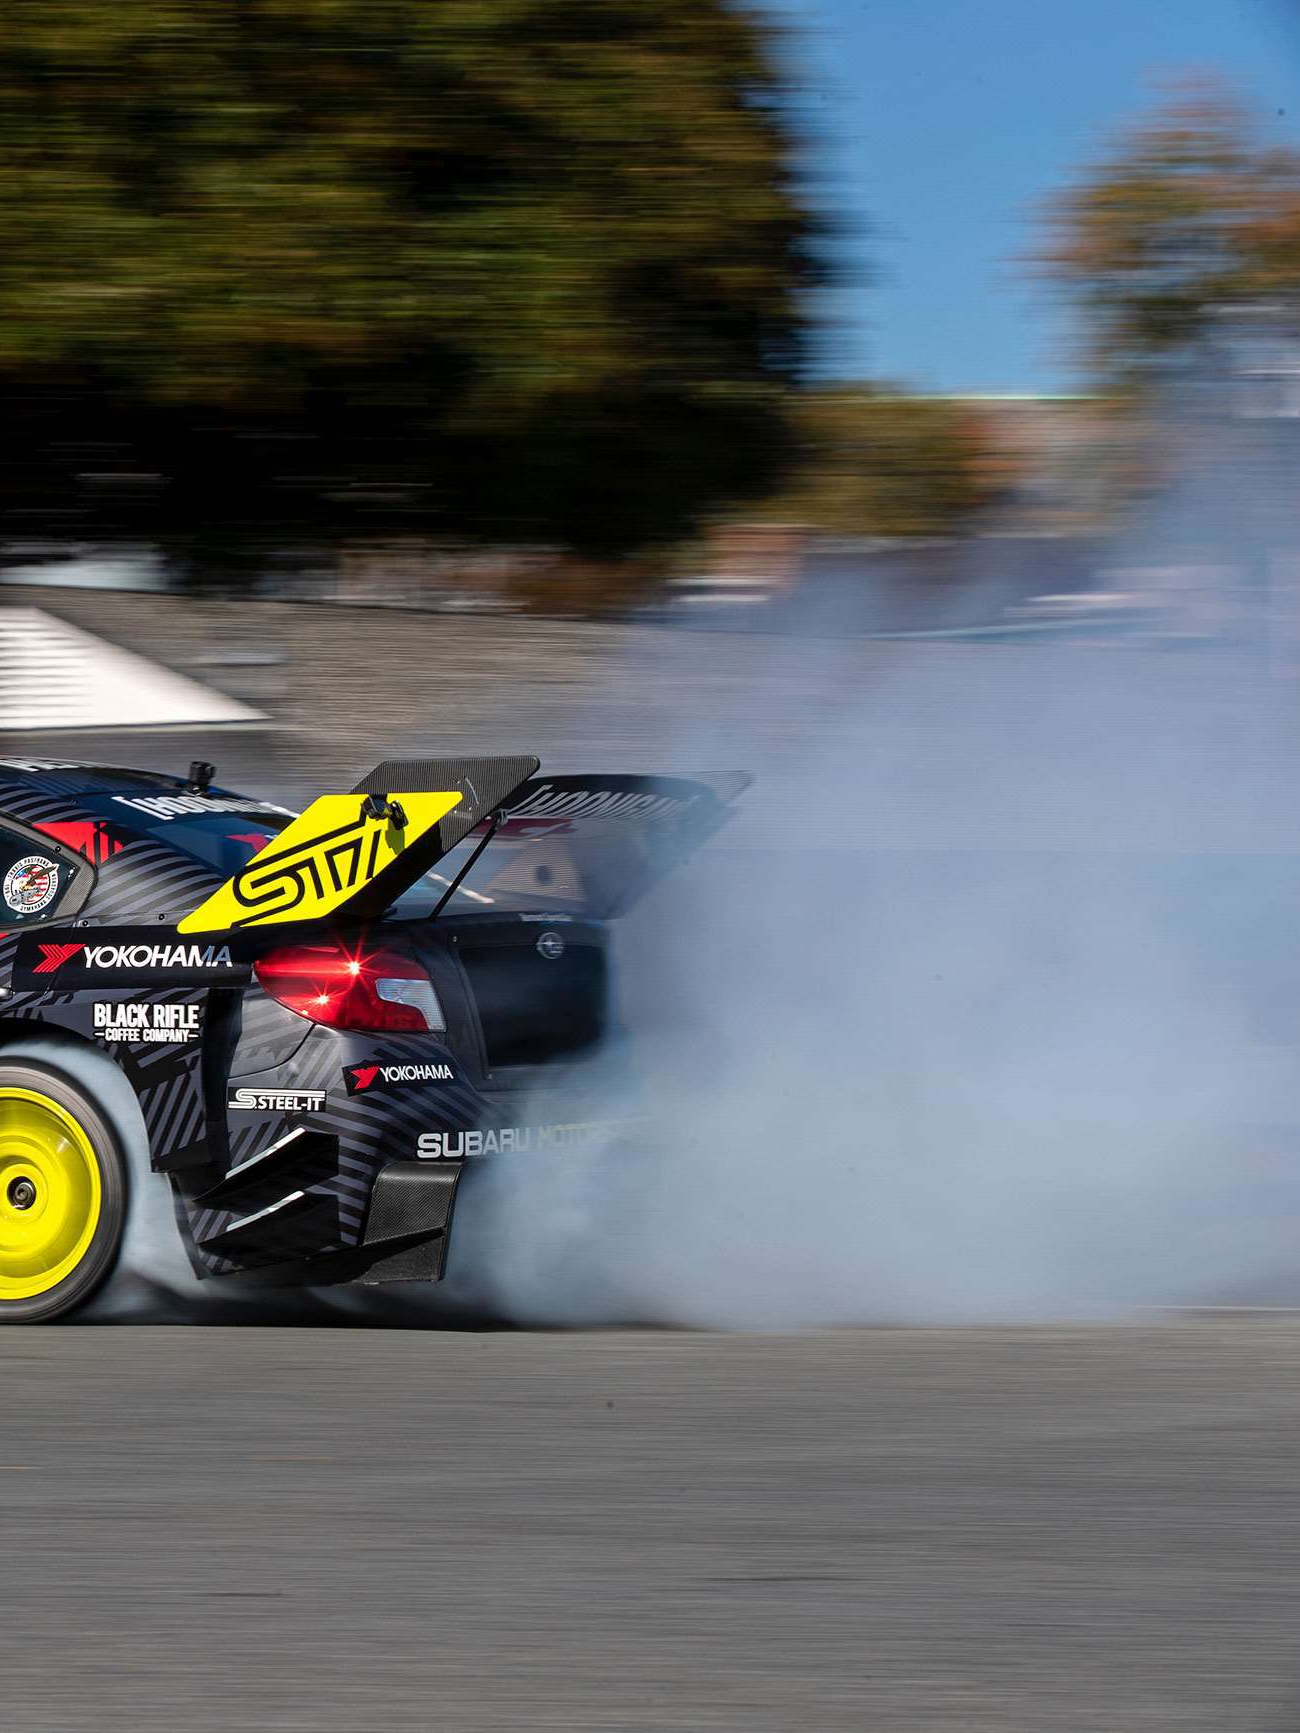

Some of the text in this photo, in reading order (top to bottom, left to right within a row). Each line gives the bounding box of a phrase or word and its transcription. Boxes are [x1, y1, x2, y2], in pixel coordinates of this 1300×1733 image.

[230, 807, 382, 928] STI
[83, 945, 234, 968] YOKOHAMA
[94, 1003, 200, 1029] BLACK RIFLE
[104, 1028, 190, 1043] COFFEE COMPANY
[379, 1064, 455, 1082] YOKOHAMA
[417, 1126, 531, 1159] SUBARU
